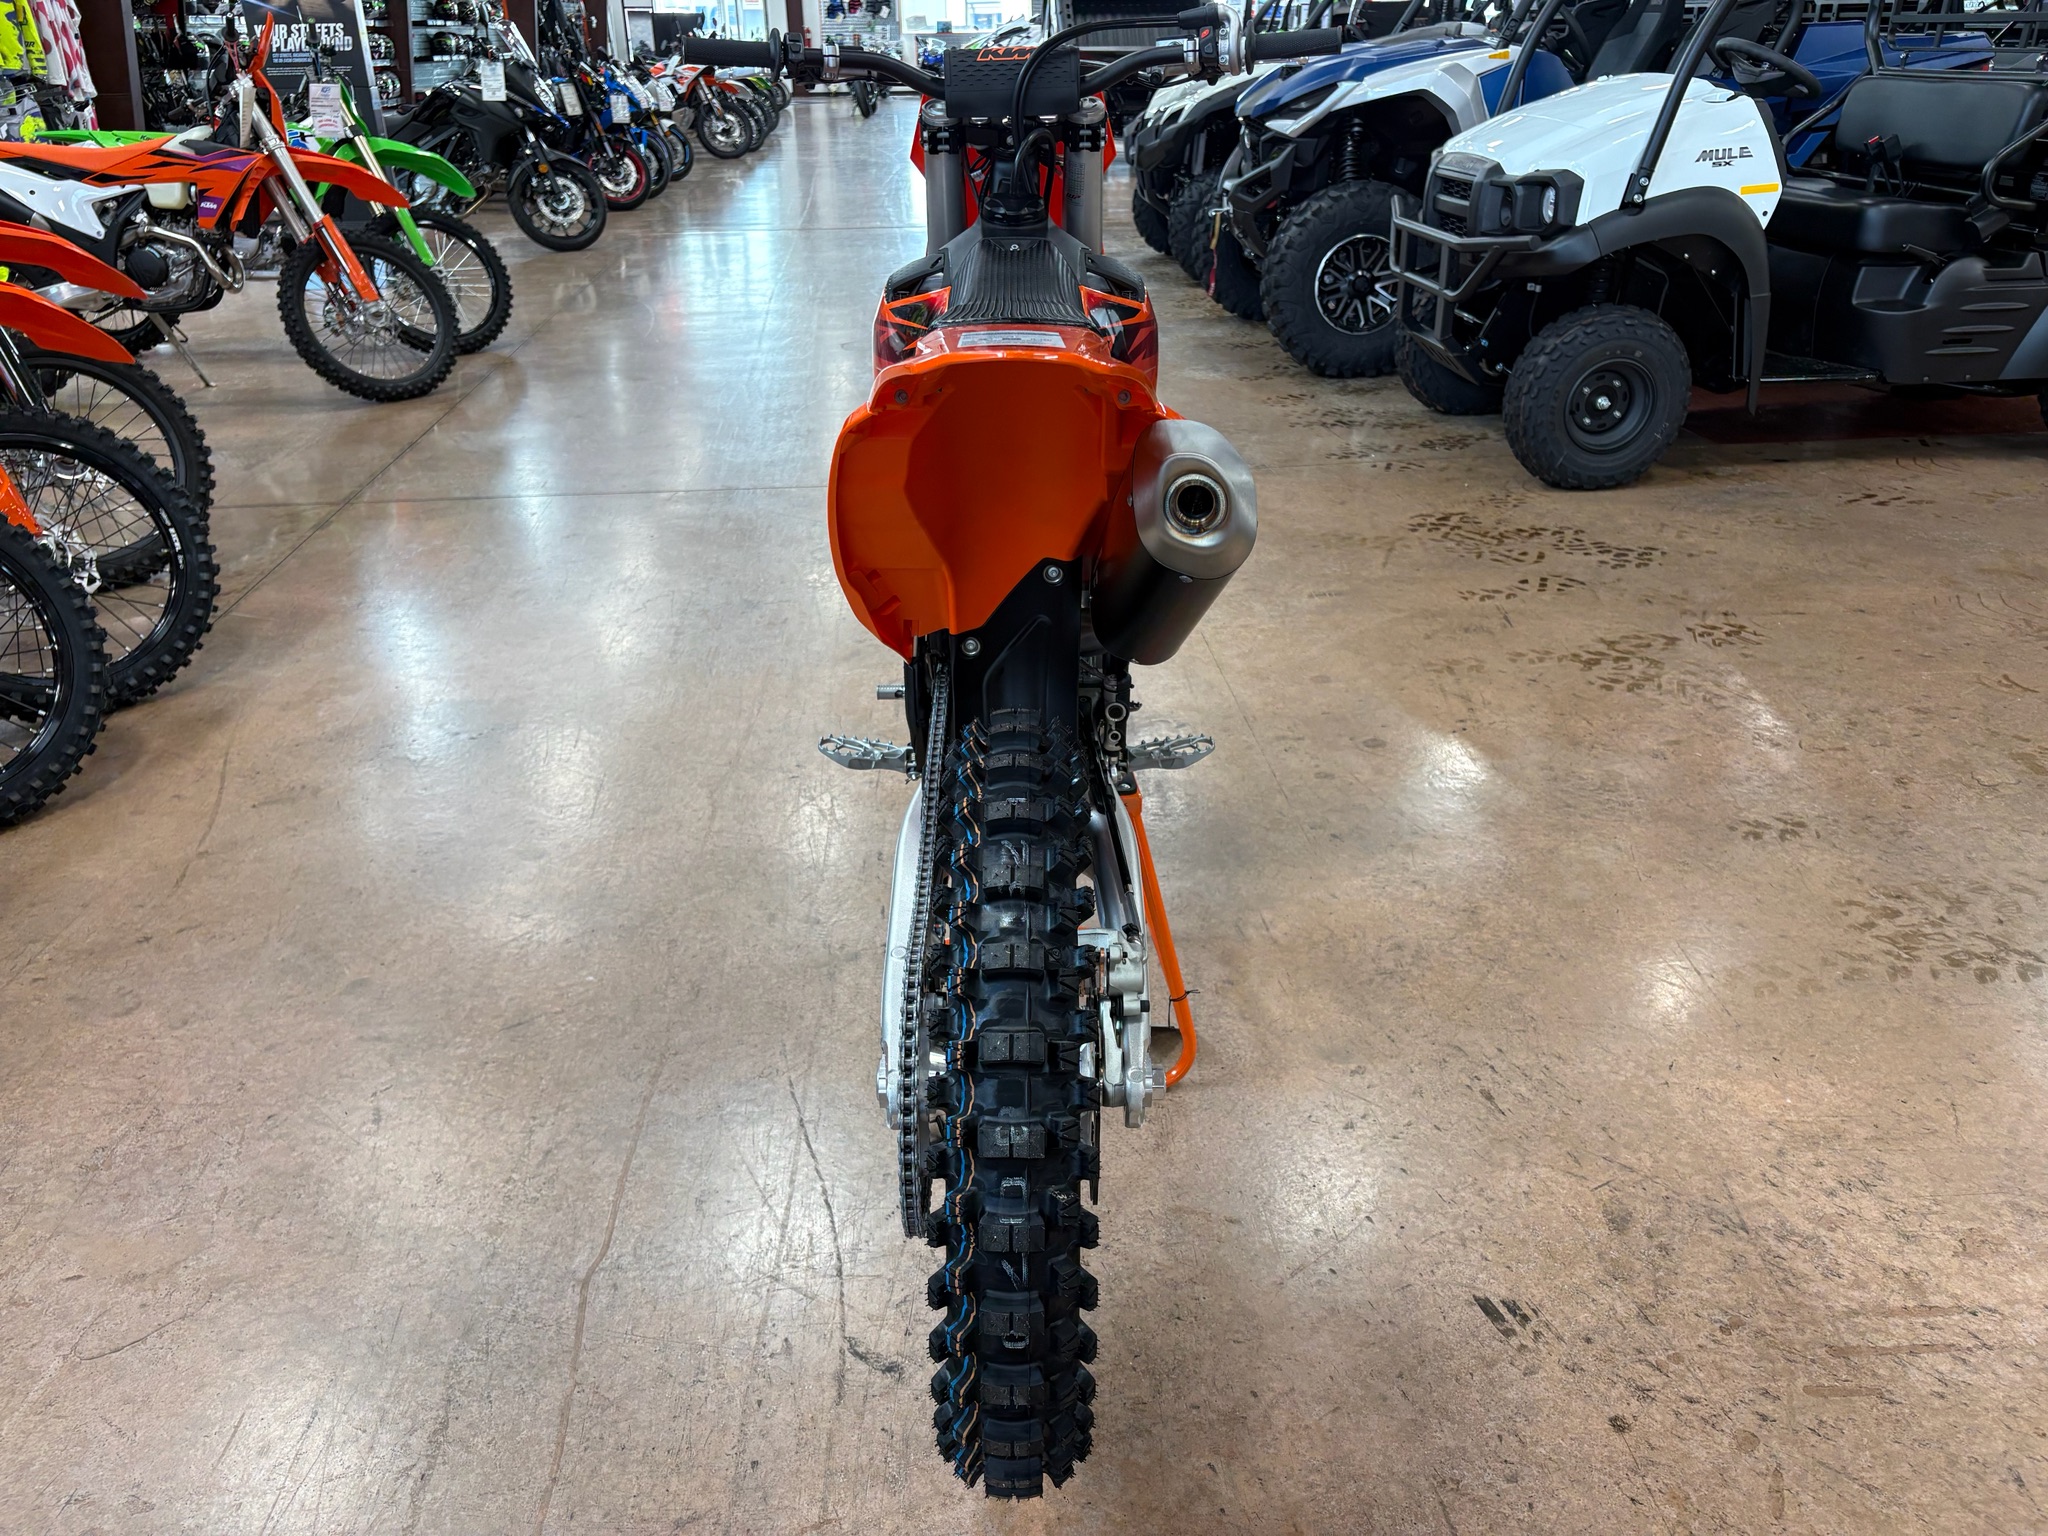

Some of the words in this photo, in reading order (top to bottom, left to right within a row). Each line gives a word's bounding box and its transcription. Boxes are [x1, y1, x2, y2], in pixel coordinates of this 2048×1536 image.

[253, 24, 288, 39] YUR
[290, 23, 344, 38] STEETS
[272, 35, 353, 52] PLAYGUND
[1694, 146, 1754, 163] MULE
[1711, 160, 1735, 168] SX
[200, 201, 218, 210] KTM
